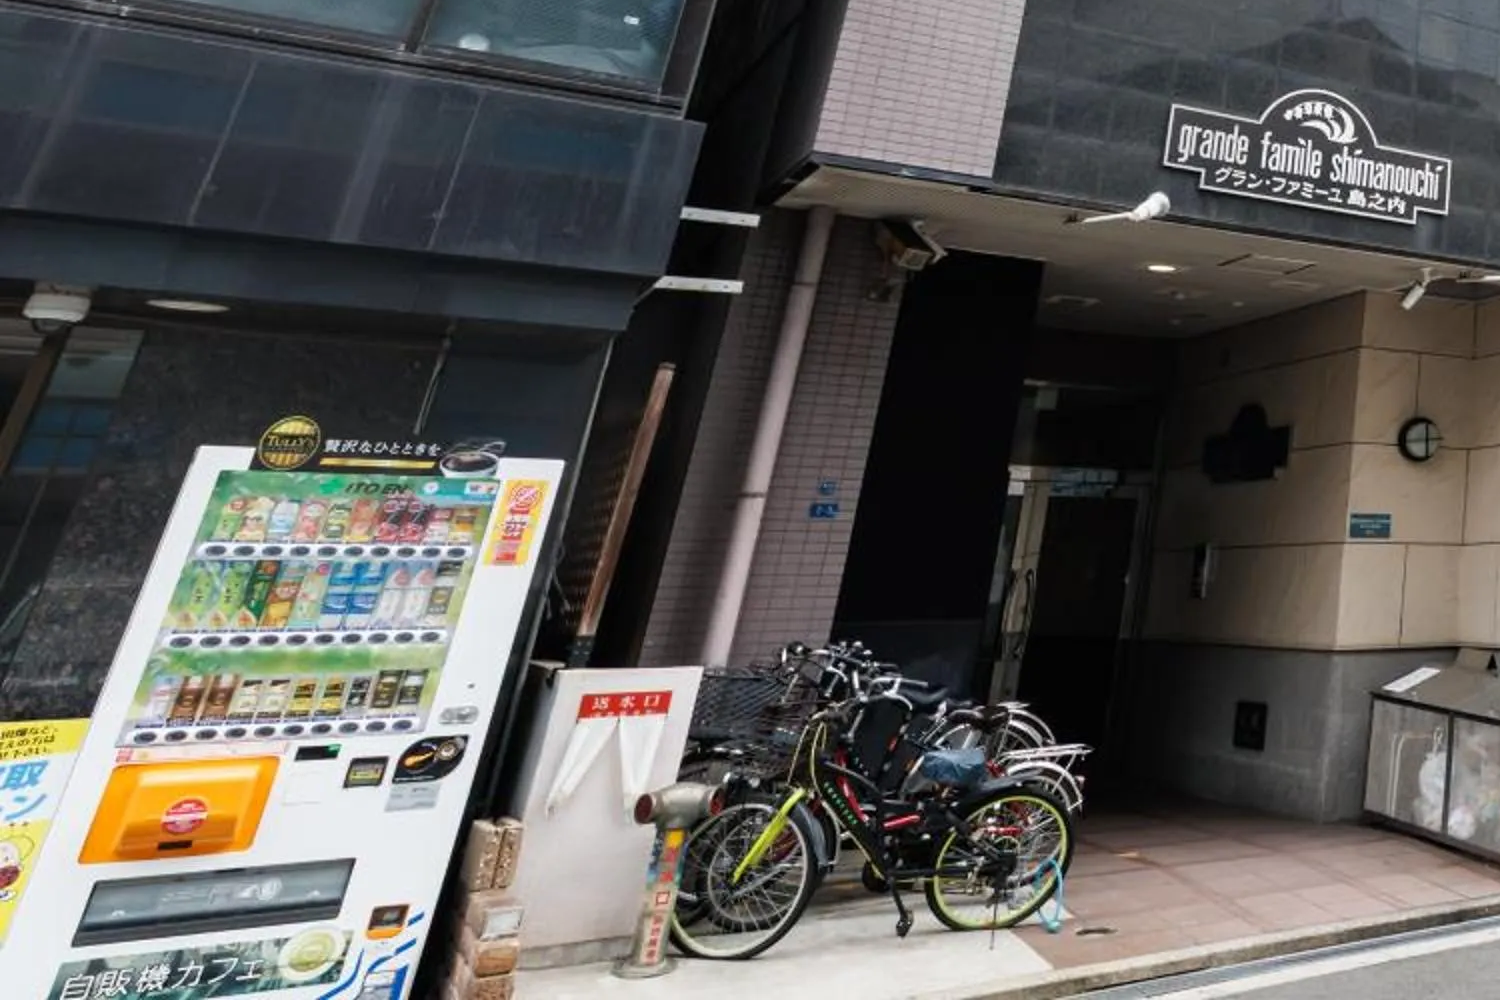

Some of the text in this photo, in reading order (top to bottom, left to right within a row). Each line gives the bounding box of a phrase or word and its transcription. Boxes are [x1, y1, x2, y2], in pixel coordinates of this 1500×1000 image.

[1178, 124, 1445, 200] grande famile shimanouchi
[1347, 188, 1407, 214] 島之内
[344, 482, 410, 495] ITO EN
[59, 956, 264, 1000] 自販機カフェ
